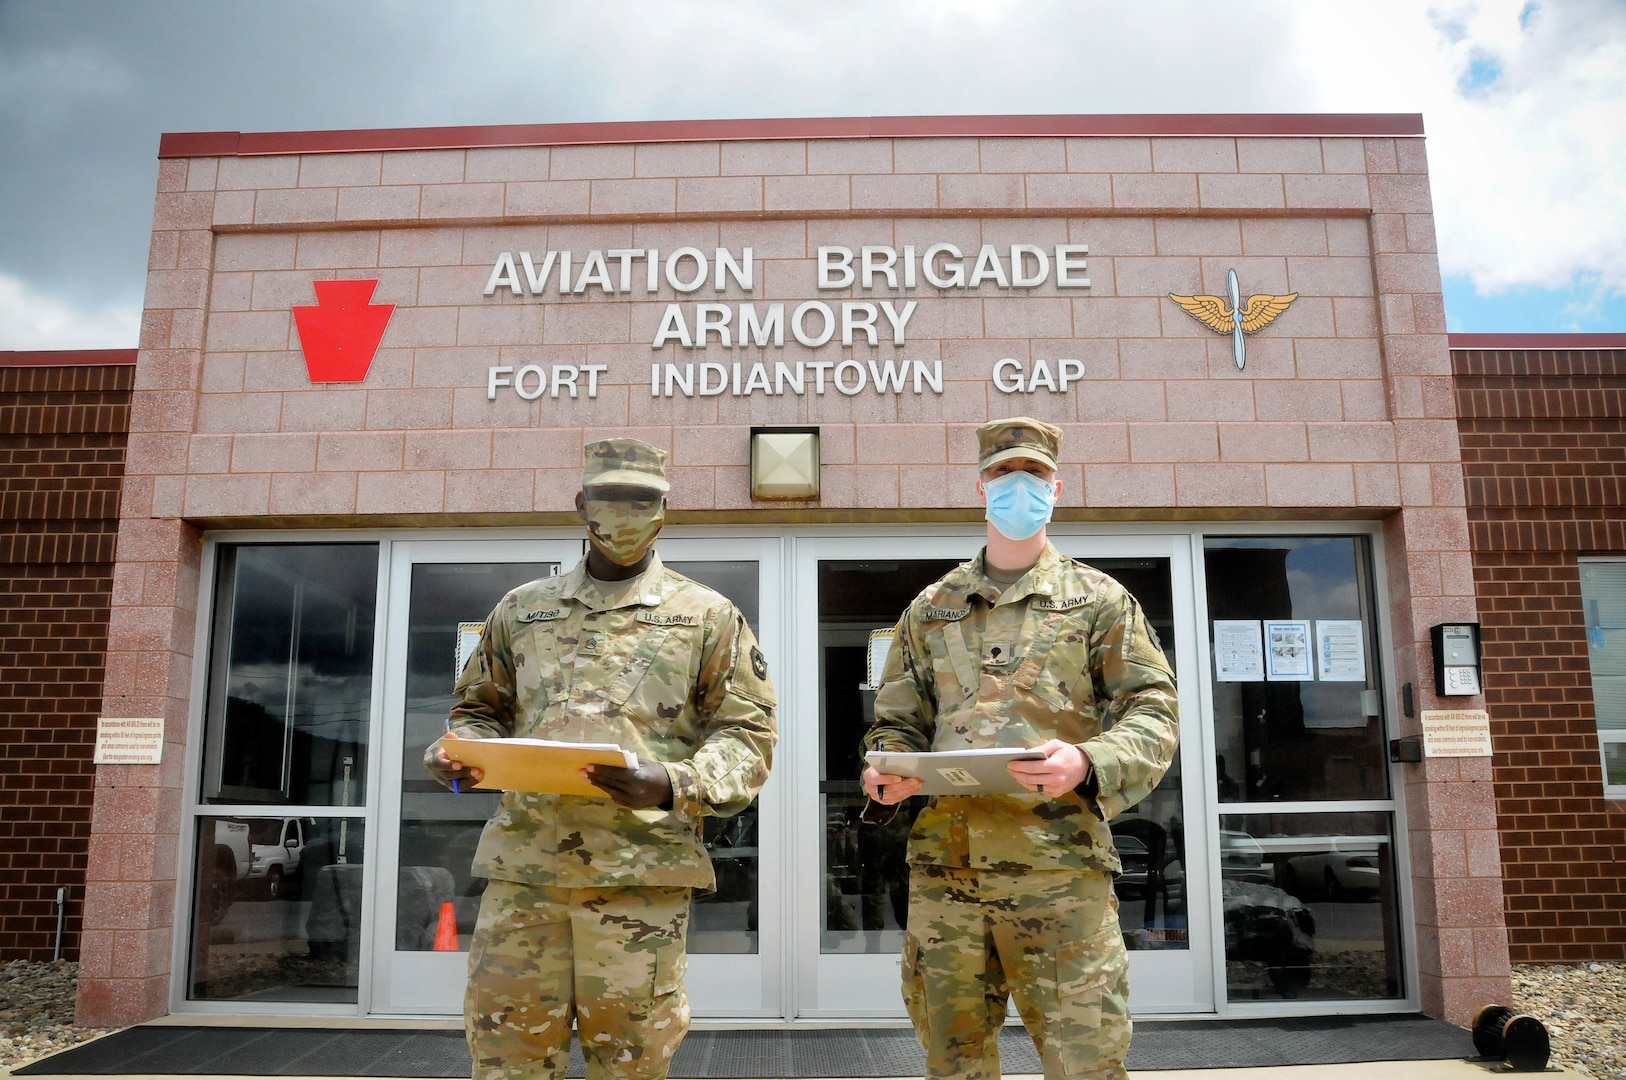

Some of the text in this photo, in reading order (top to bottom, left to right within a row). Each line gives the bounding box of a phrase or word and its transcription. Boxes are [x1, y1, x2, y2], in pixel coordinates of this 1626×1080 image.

[483, 242, 1091, 296] AVIATION BRIGADE
[652, 300, 918, 349] ARMORY
[487, 357, 1086, 400] FORT INDIANTOWN GAP
[644, 613, 694, 624] U.S. ARMY
[1040, 595, 1089, 609] U.S. ARMY
